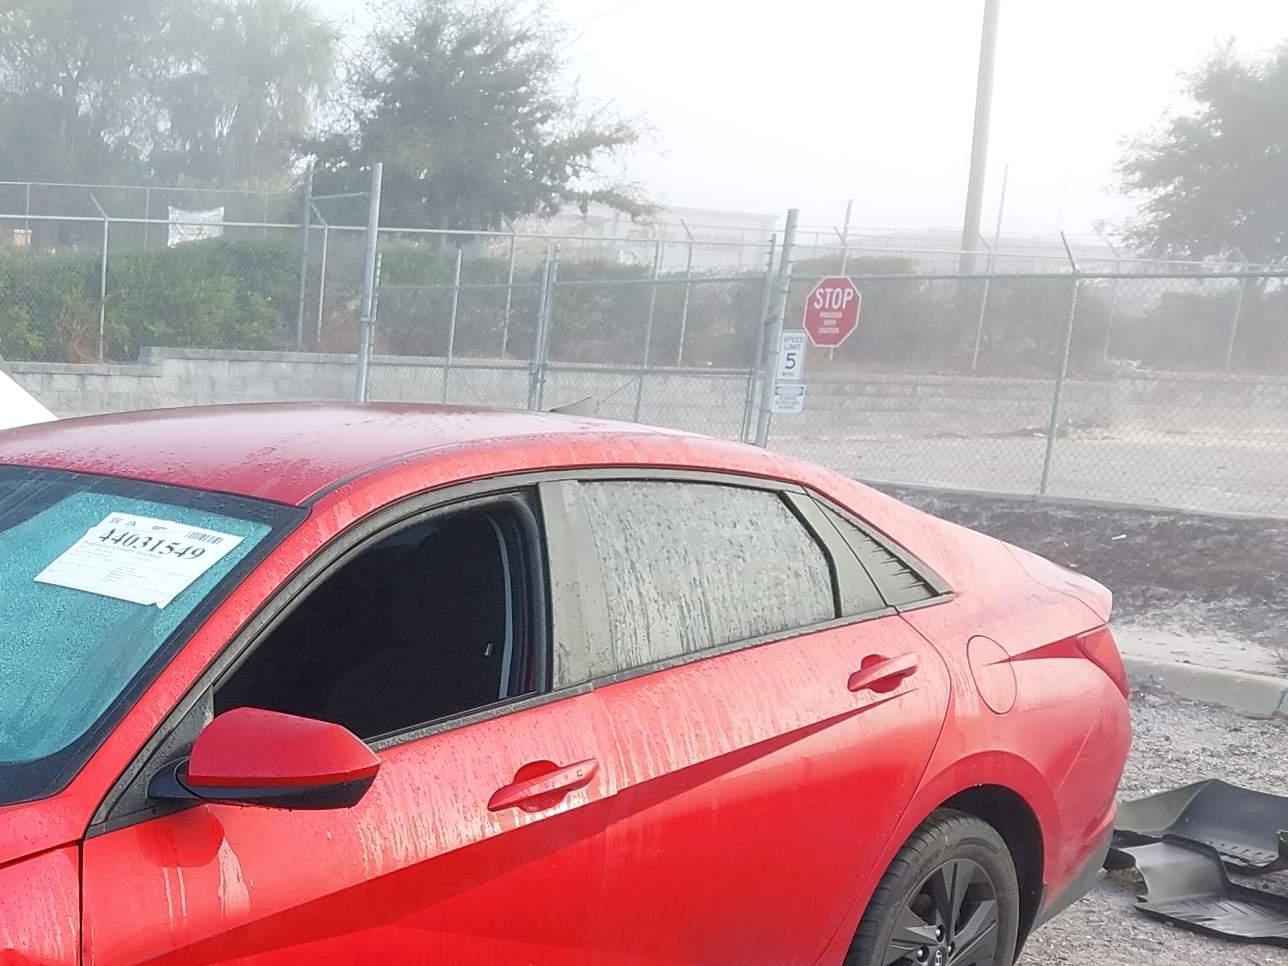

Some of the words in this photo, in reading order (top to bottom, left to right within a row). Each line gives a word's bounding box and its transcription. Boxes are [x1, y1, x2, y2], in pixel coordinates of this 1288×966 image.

[814, 288, 853, 309] STOP
[785, 352, 797, 370] 5
[98, 528, 206, 560] 44031549
